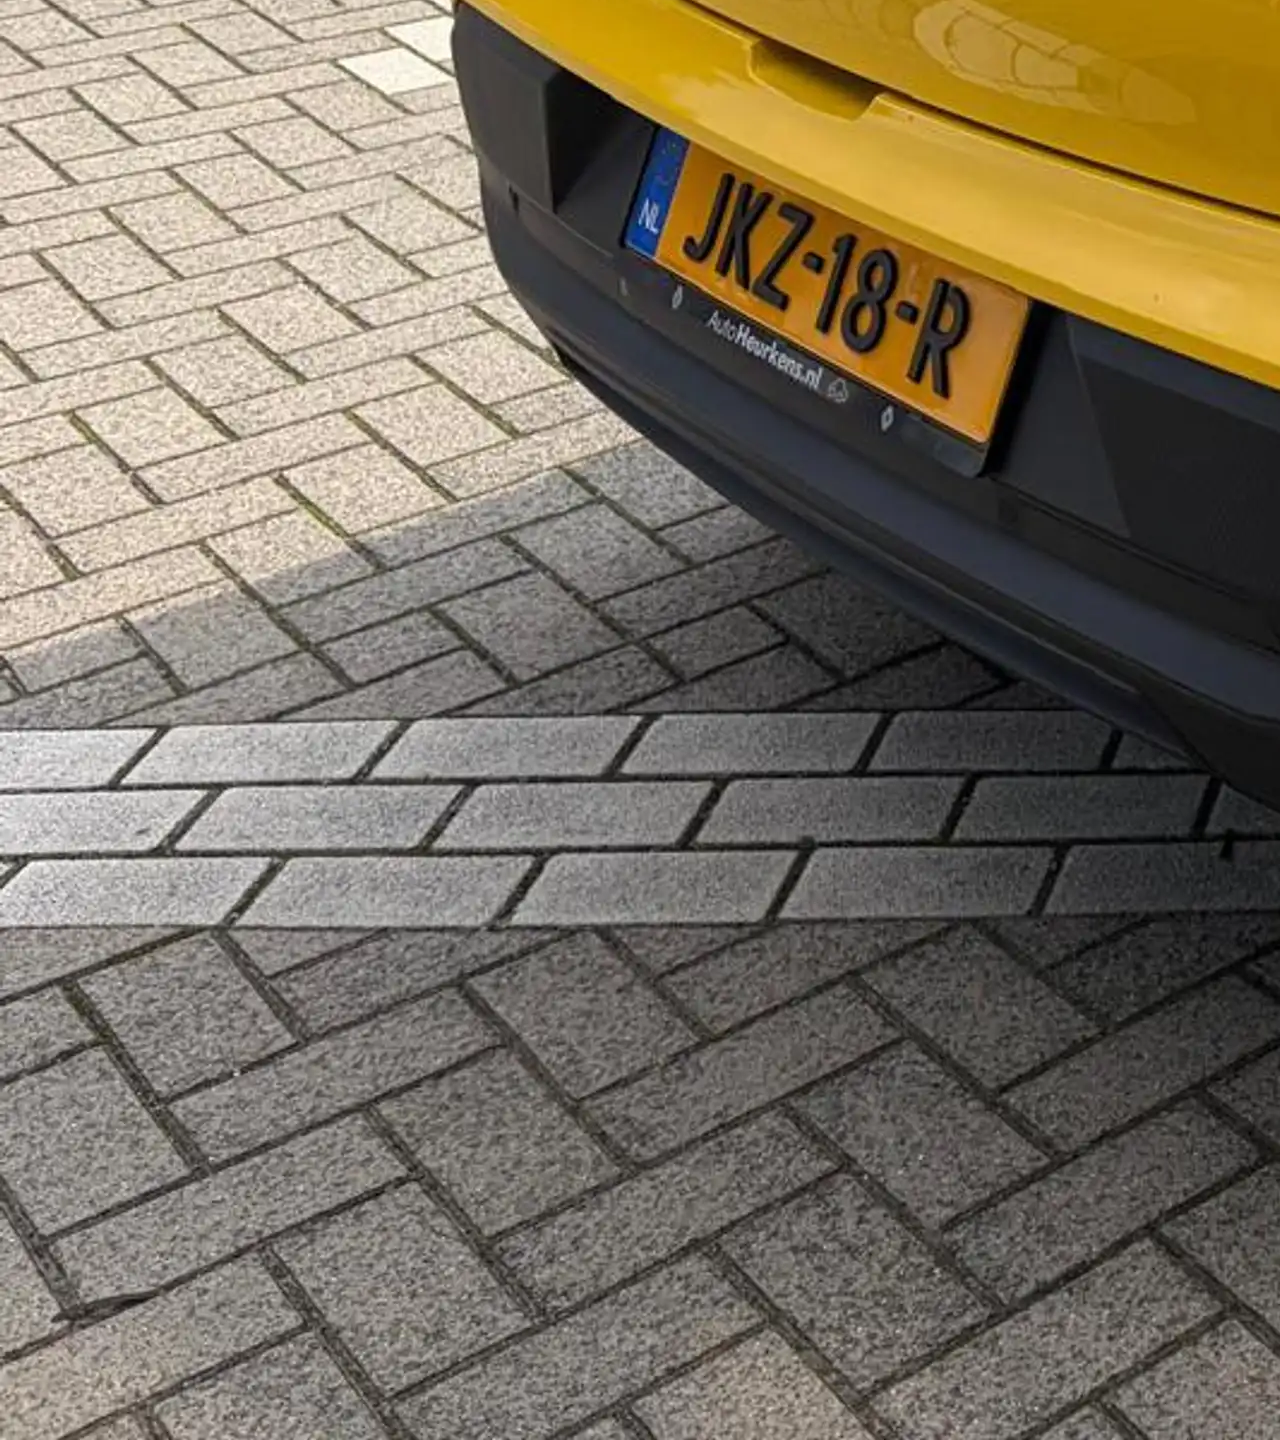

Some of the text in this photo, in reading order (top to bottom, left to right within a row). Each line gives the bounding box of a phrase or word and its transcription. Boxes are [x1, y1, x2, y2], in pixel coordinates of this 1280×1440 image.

[638, 198, 660, 236] NL
[682, 172, 973, 400] JKZ-18-R
[705, 310, 823, 392] AutoHeurkens.nl
